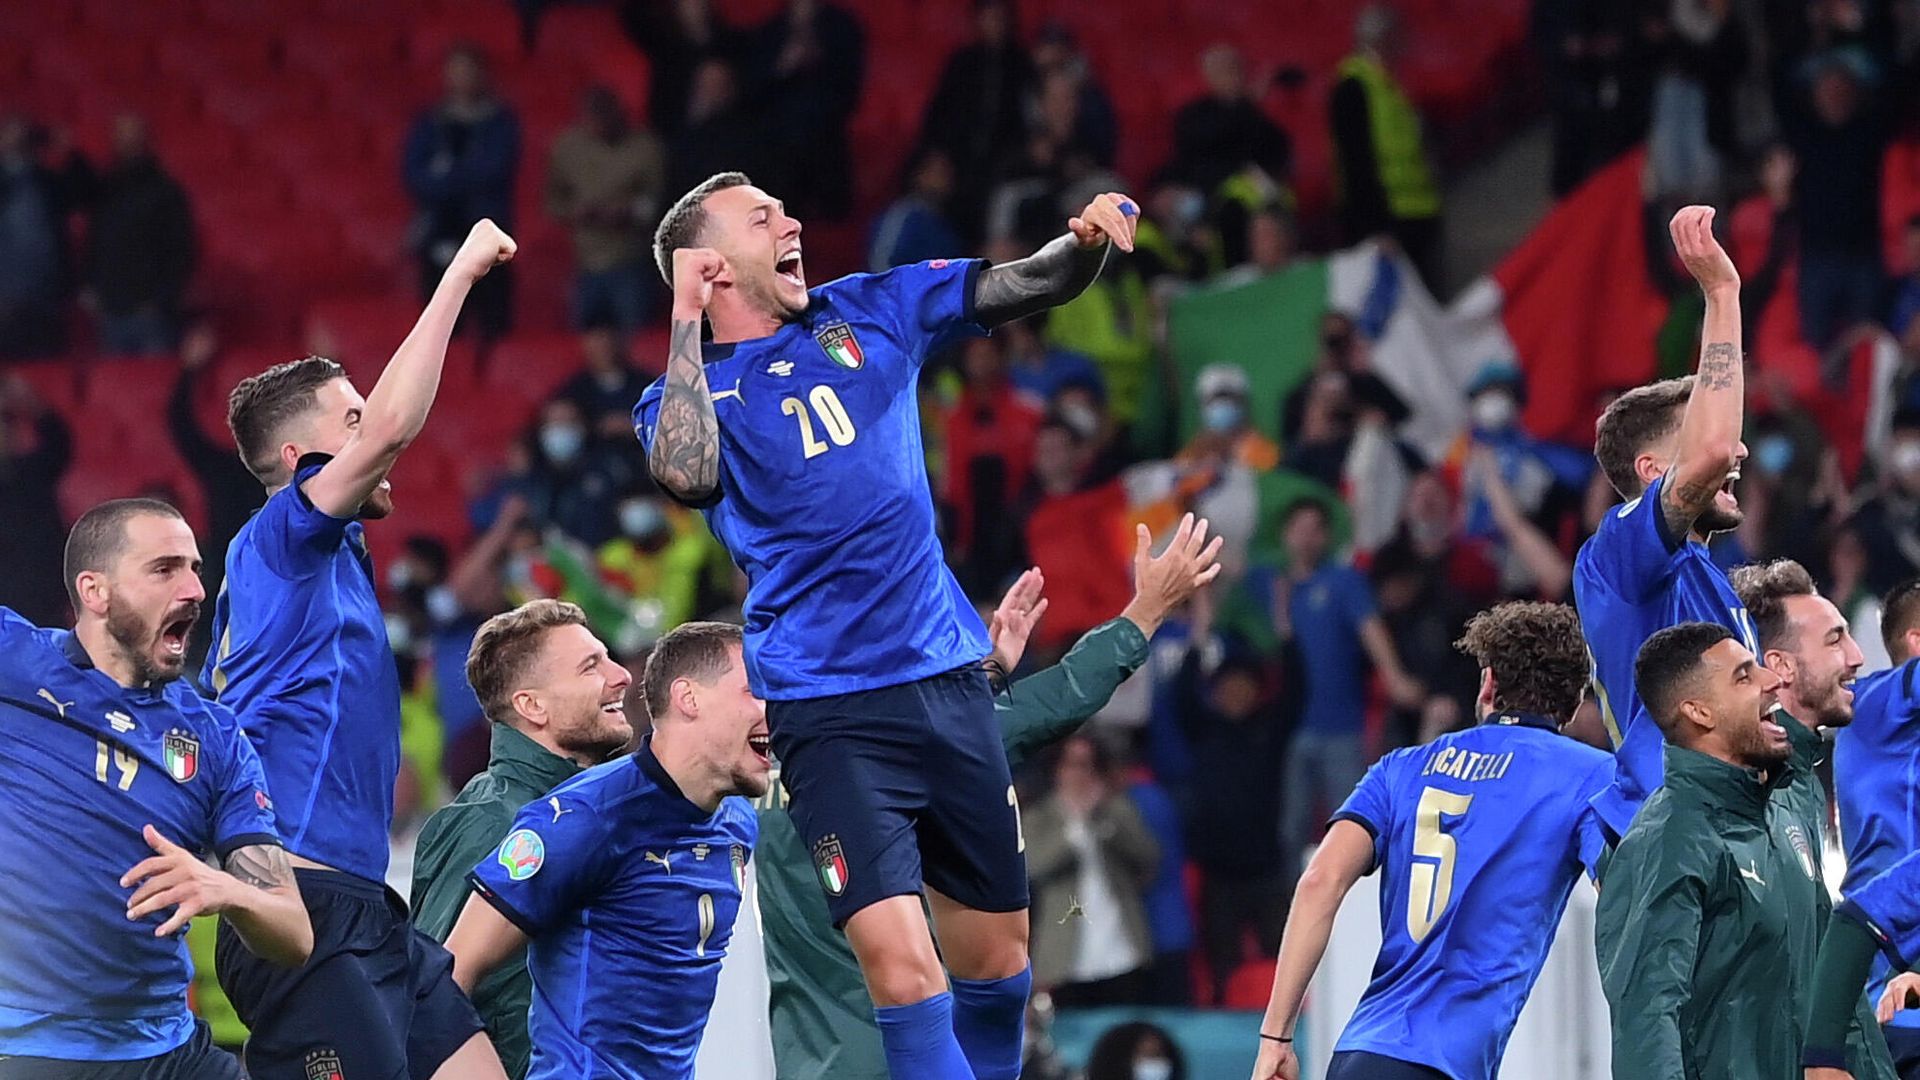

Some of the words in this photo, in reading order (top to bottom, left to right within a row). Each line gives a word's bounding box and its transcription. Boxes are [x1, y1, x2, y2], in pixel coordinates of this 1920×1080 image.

[781, 384, 856, 459] 20
[95, 740, 139, 791] 19
[1406, 785, 1474, 945] 5
